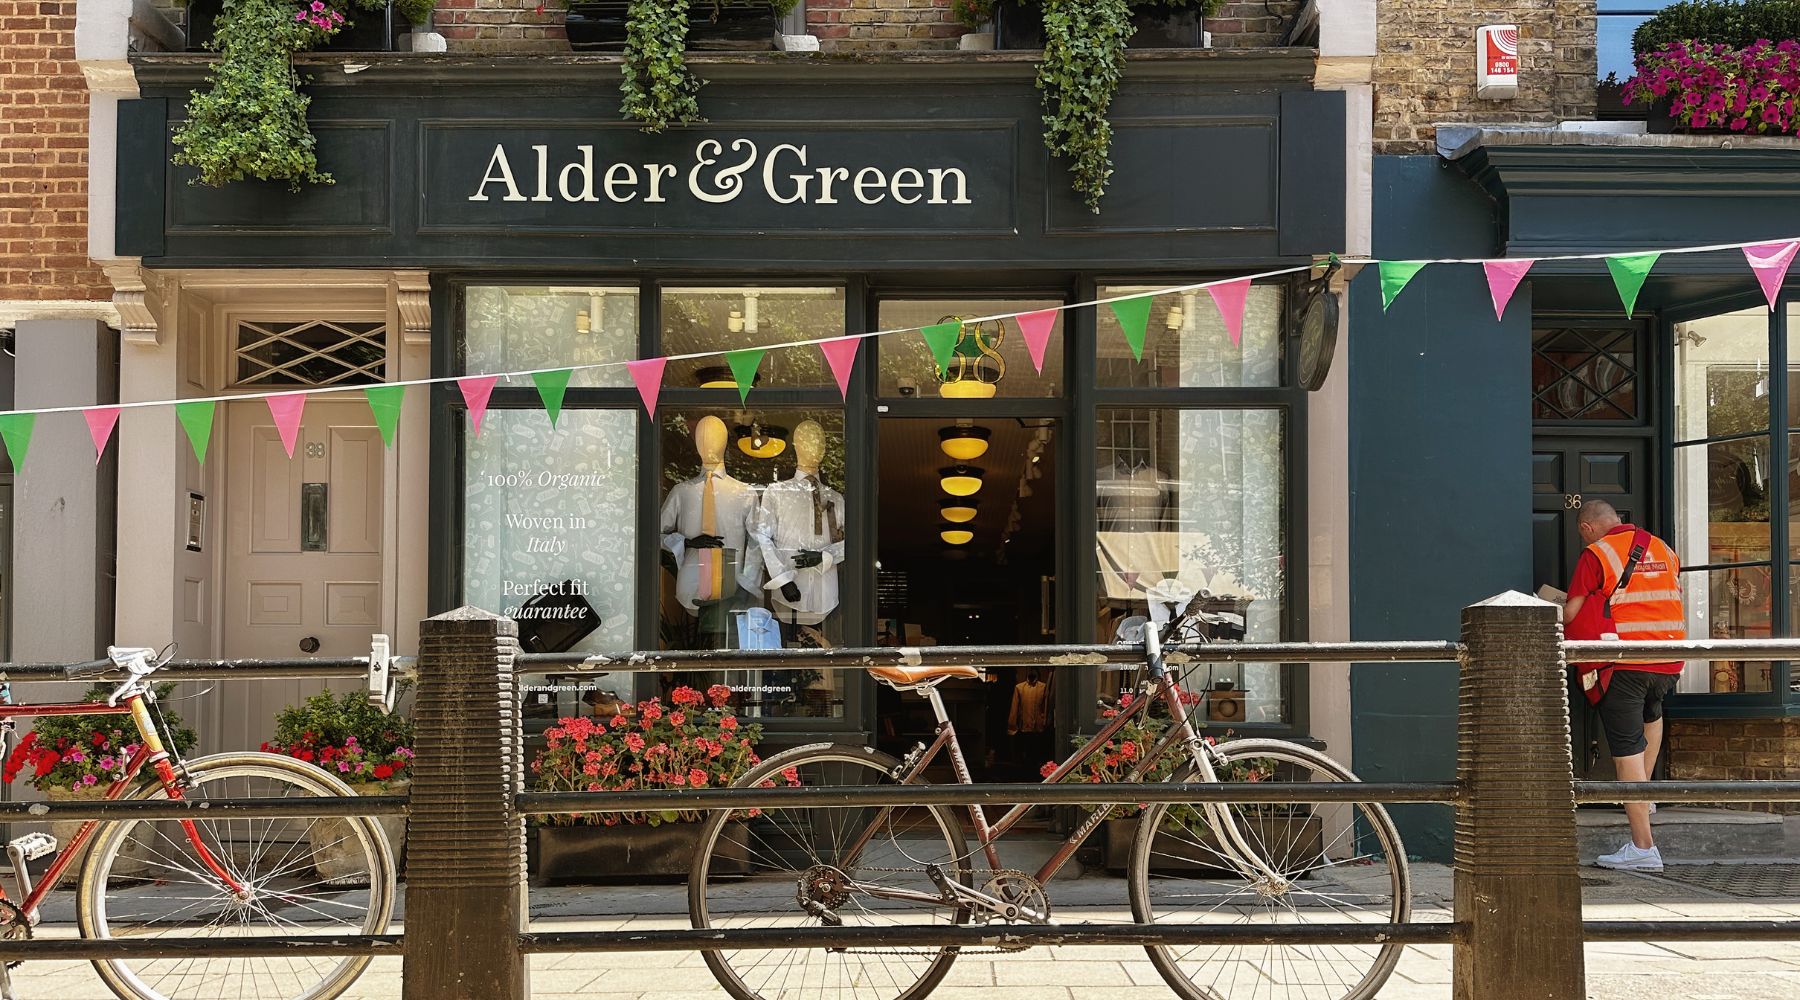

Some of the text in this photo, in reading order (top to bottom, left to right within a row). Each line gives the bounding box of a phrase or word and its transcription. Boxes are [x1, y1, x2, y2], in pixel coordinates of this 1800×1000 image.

[468, 138, 973, 204] Alder & Green
[304, 441, 326, 459] 38
[487, 470, 606, 490] 100% Organic
[1564, 494, 1582, 509] 36
[505, 513, 586, 530] Woven in
[526, 536, 566, 556] Italy
[503, 578, 589, 596] Perfect fit
[503, 604, 588, 620] guarantee
[519, 684, 598, 693] lderandgreen.com
[728, 685, 791, 693] alderandgreen
[1077, 802, 1111, 837] MARLB
